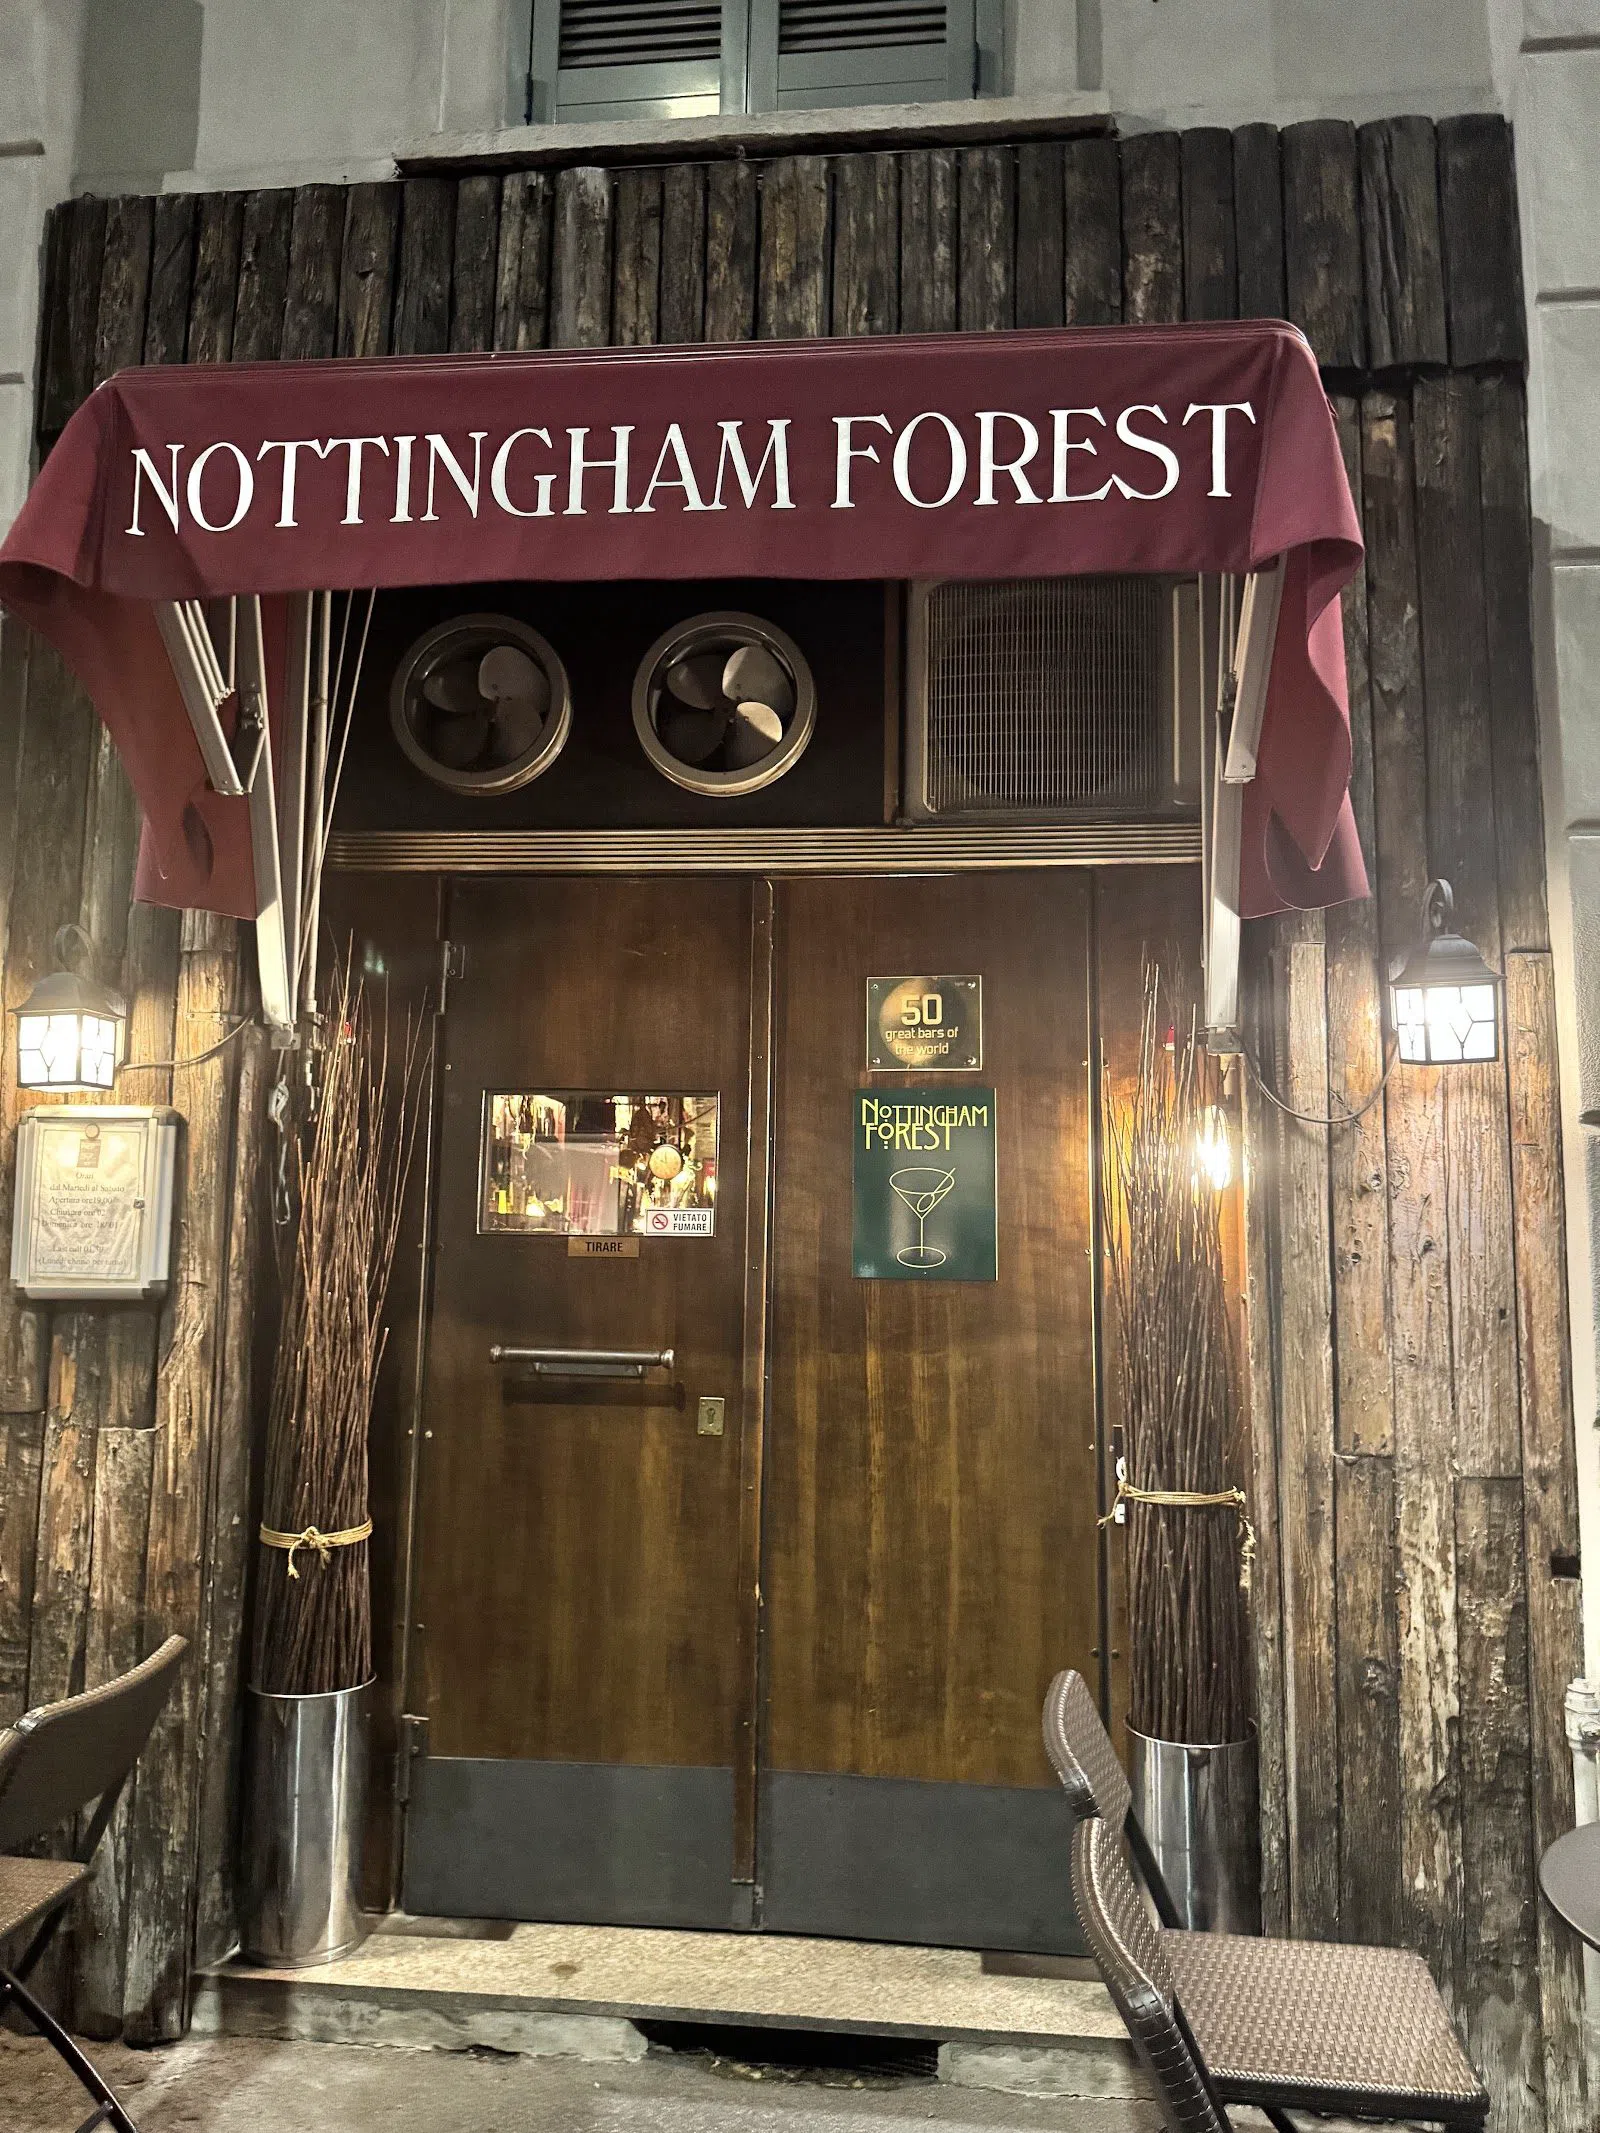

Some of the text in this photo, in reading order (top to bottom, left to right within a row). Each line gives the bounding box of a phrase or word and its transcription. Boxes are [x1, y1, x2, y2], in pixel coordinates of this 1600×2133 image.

[125, 401, 1256, 537] NOTTINGHAM FOREST
[901, 993, 943, 1026] 50
[885, 1026, 959, 1042] great bars of
[895, 1043, 949, 1055] the world
[865, 1122, 951, 1151] FOREST
[673, 1213, 707, 1222] VIETATO
[673, 1223, 707, 1231] FUMARE
[585, 1241, 623, 1252] TIRARE
